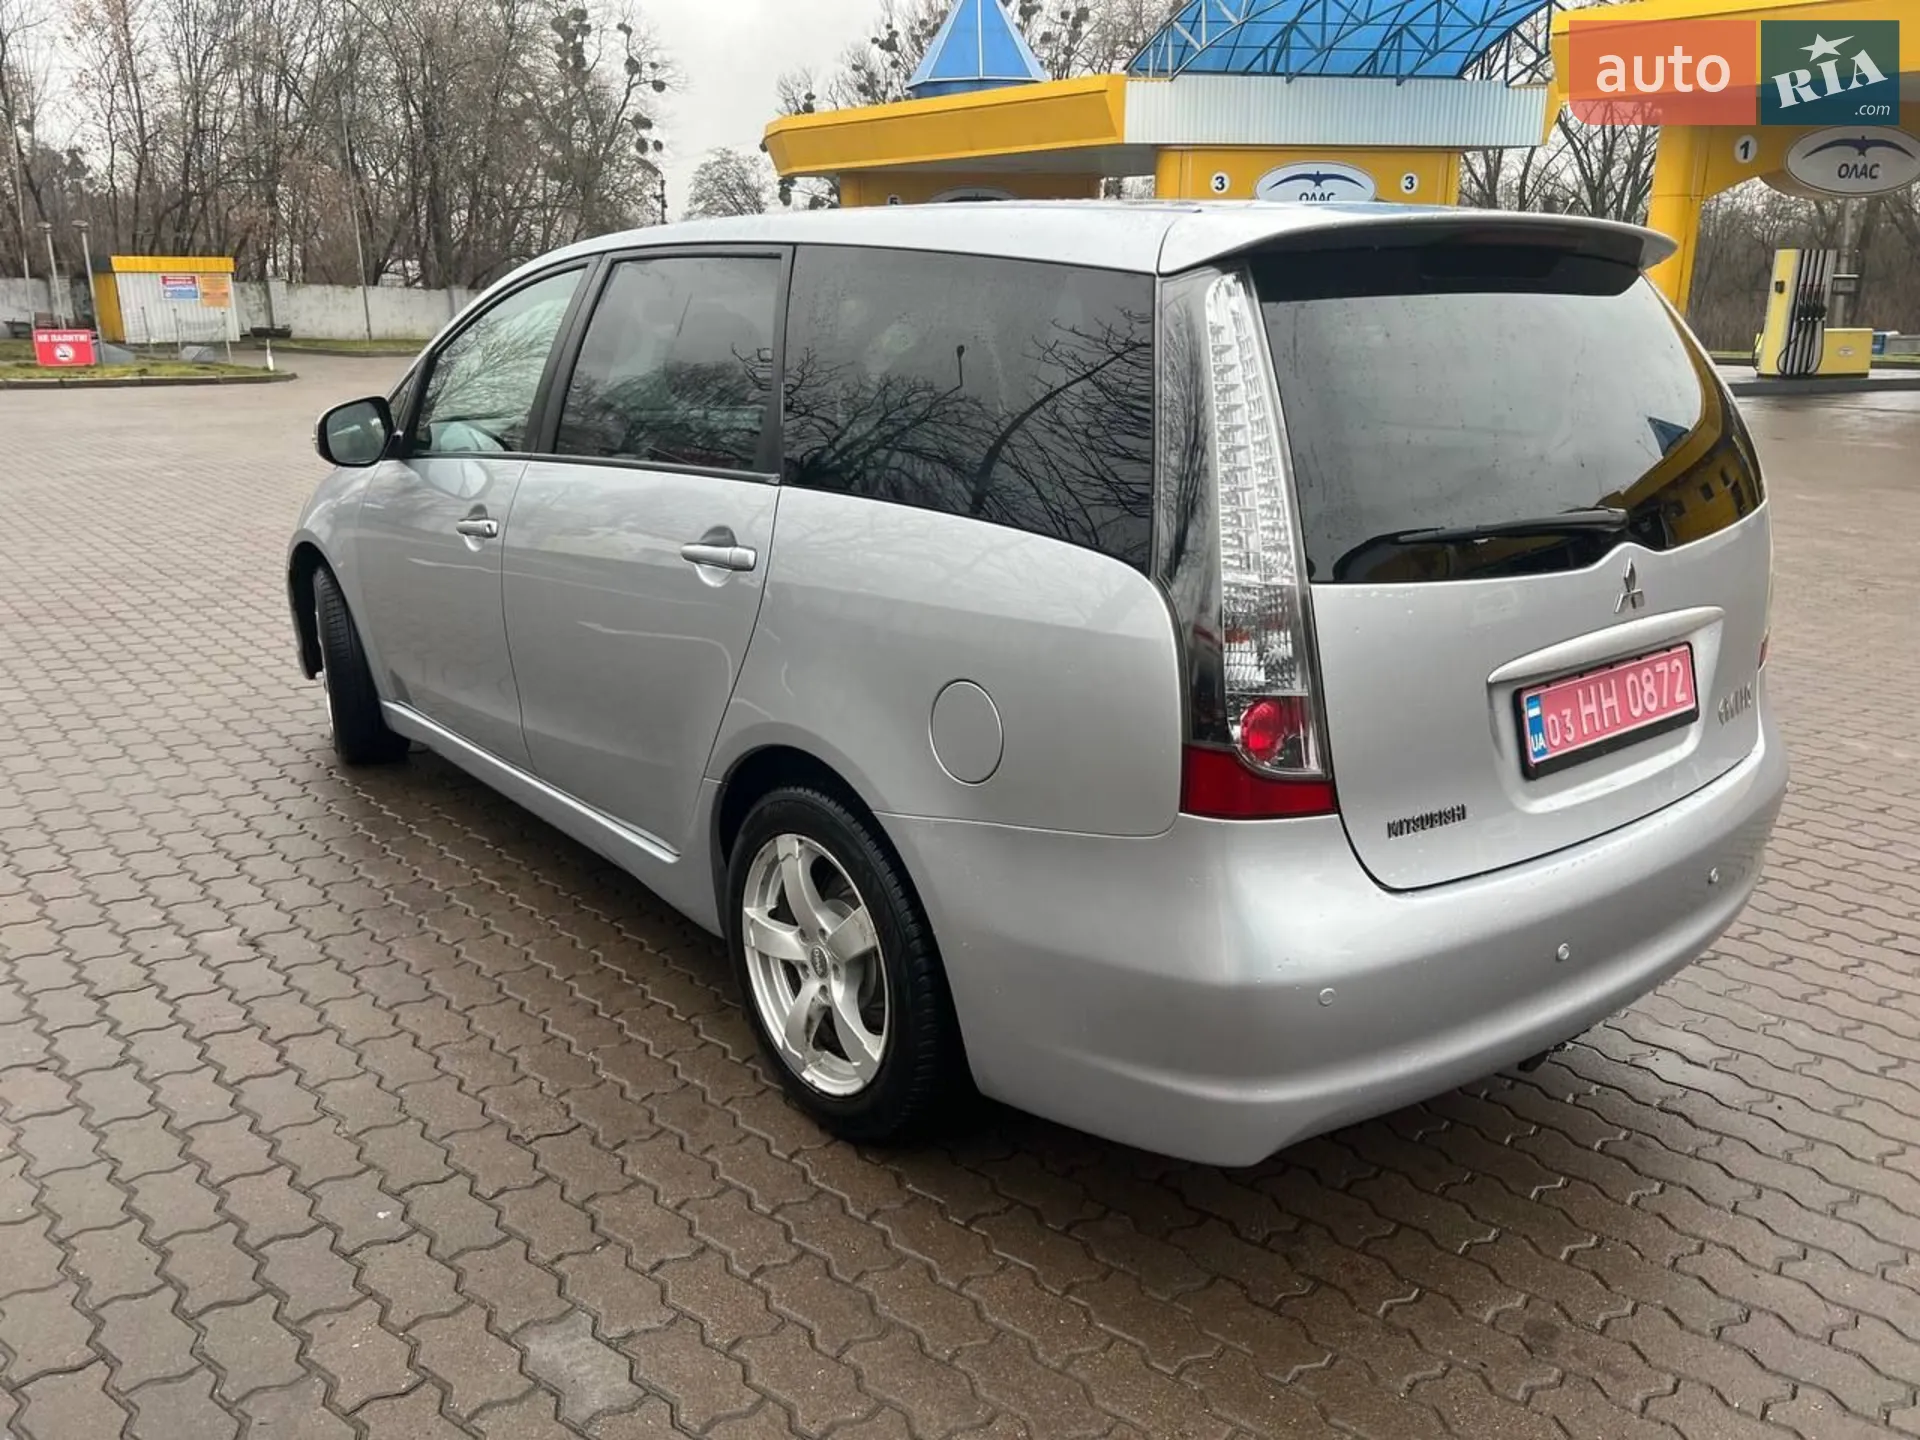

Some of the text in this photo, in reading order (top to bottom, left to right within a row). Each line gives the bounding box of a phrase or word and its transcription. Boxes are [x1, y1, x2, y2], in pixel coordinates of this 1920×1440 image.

[1740, 140, 1750, 160] 1
[1837, 163, 1880, 179] ОЛАС
[1214, 176, 1225, 191] 3
[1404, 175, 1415, 191] 3
[1547, 708, 1575, 747] 03
[1577, 679, 1621, 735] HH
[1626, 659, 1687, 718] 0872
[1530, 734, 1547, 752] UA
[1387, 804, 1467, 839] MITSUBISHI
